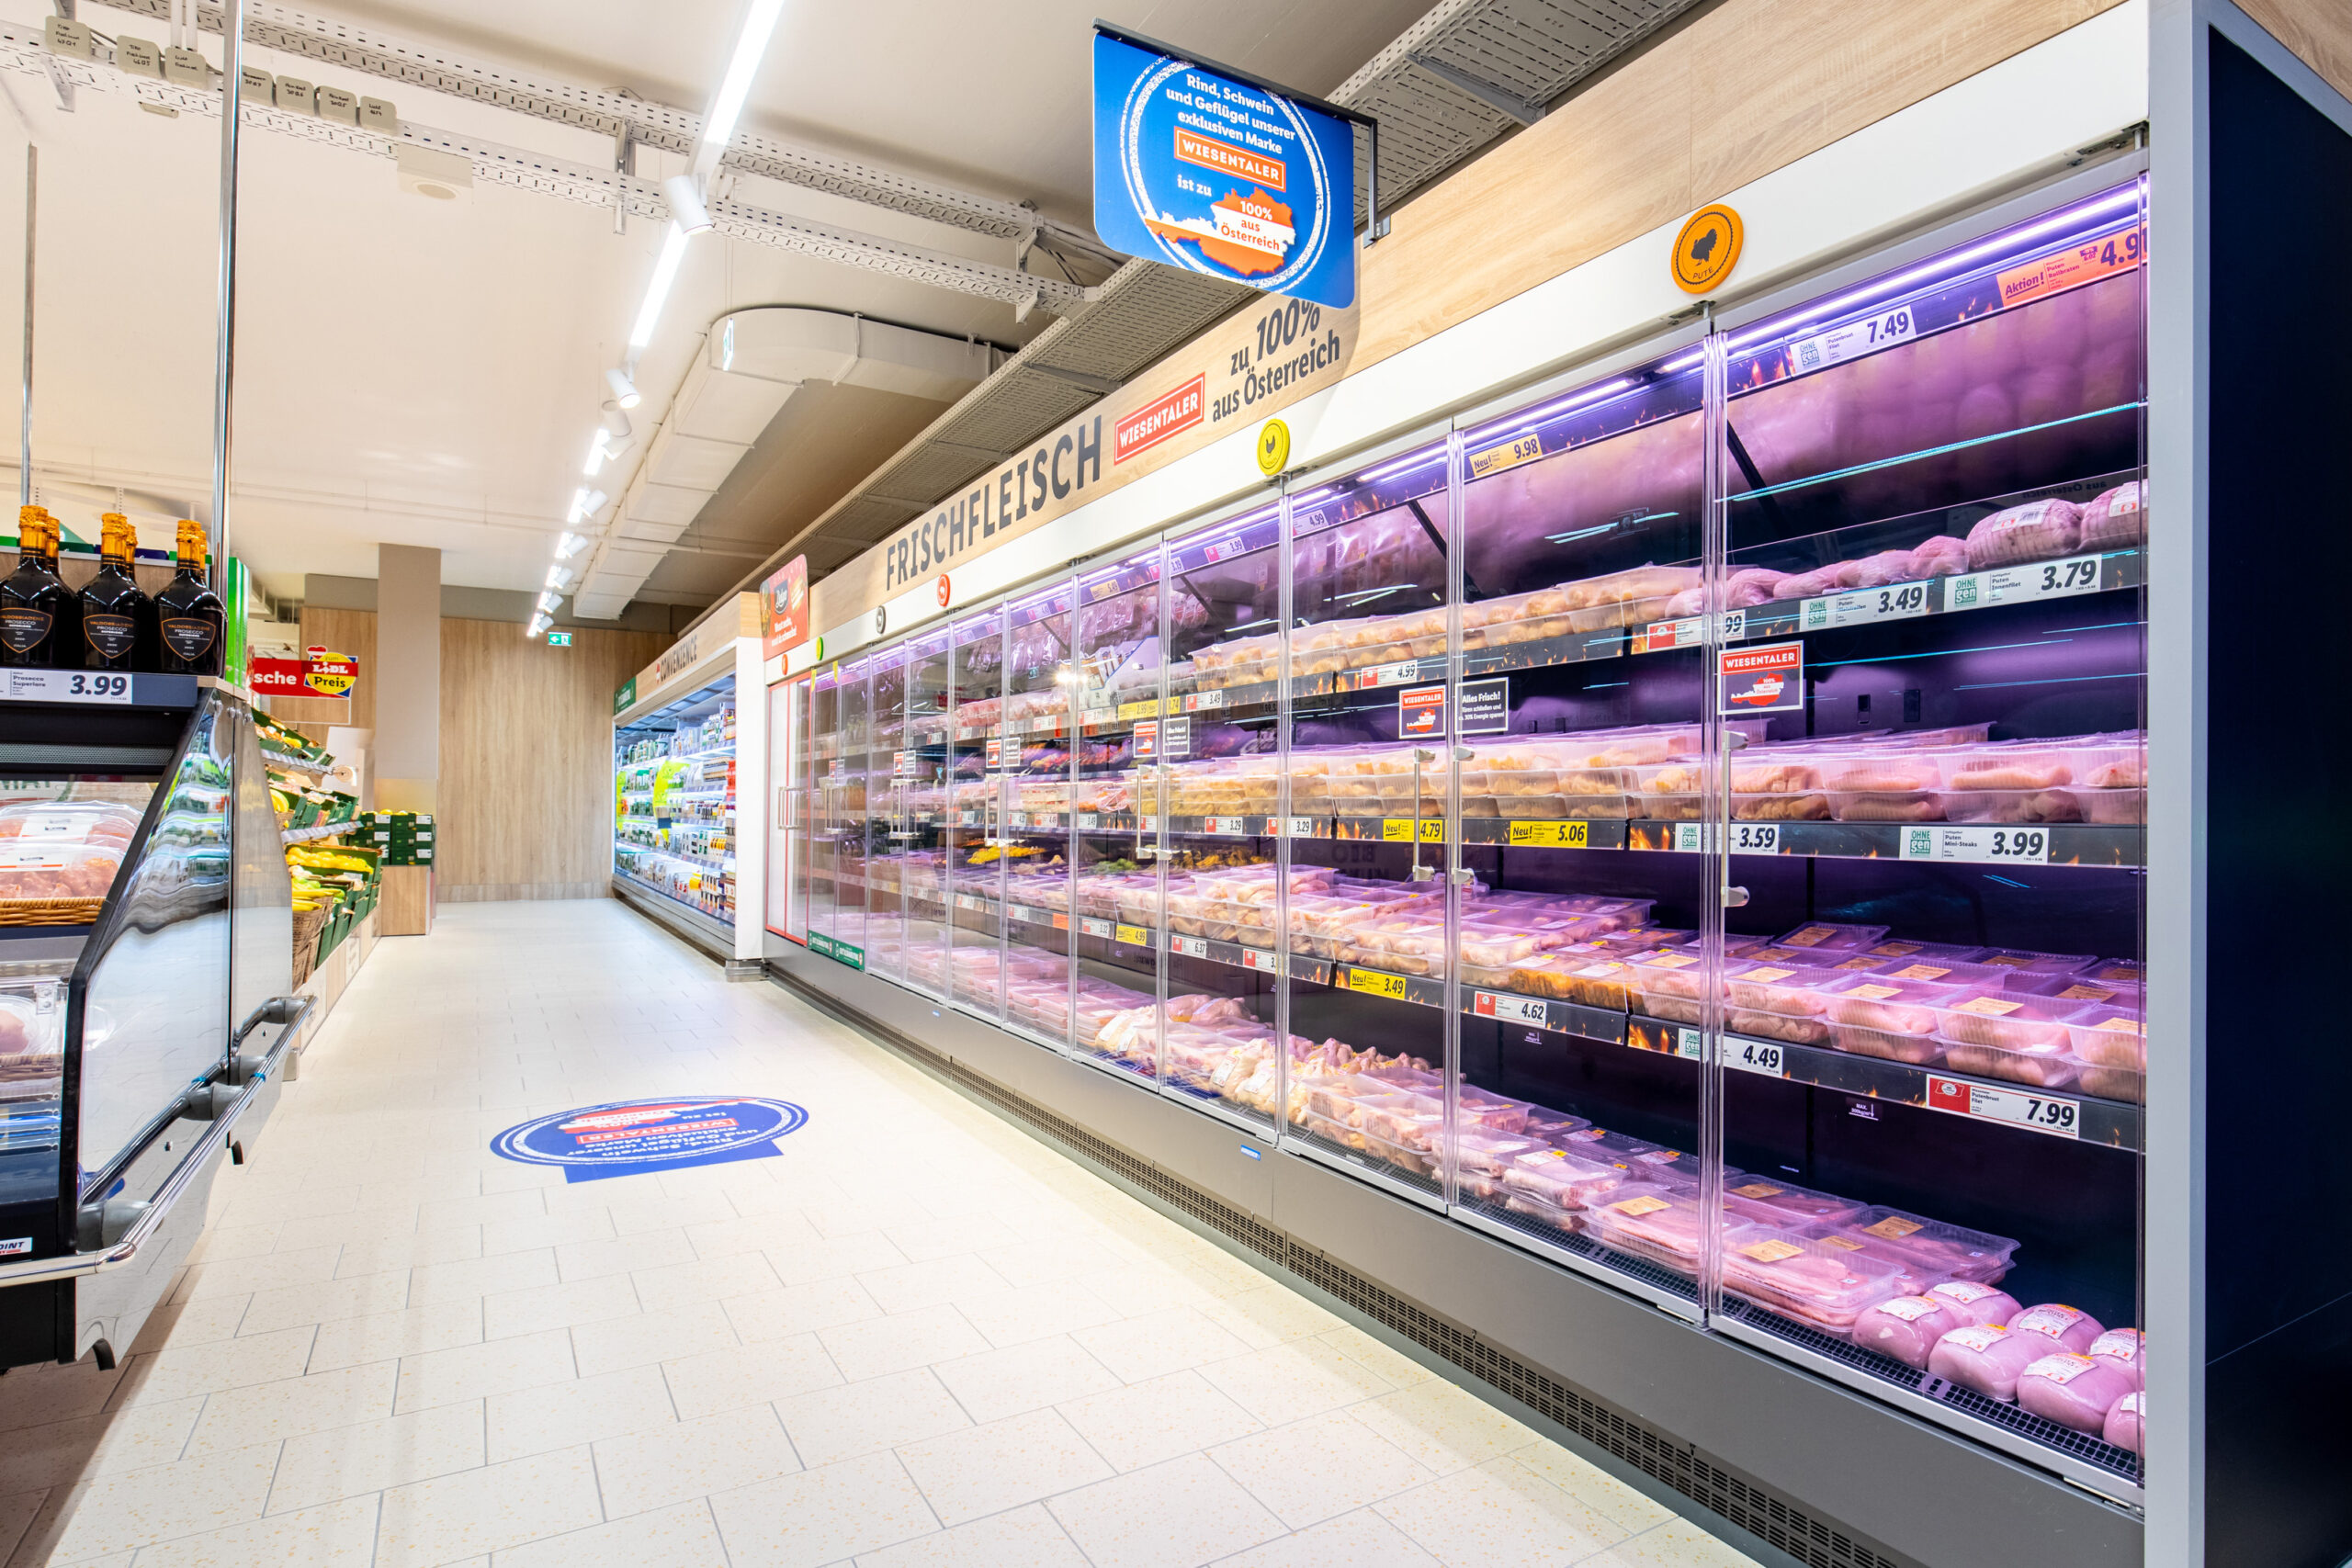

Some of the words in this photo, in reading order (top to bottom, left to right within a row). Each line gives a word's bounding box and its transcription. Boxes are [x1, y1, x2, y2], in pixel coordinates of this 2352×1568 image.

[1187, 73, 1221, 99] Rind,
[1224, 87, 1273, 116] Schwein
[1166, 88, 1193, 107] und
[1194, 96, 1250, 127] Geflügel
[1252, 117, 1295, 141] unserer
[1178, 112, 1243, 141] exklusiven
[1246, 134, 1283, 154] Marke
[1182, 138, 1279, 181] WIESENTALER
[1178, 175, 1193, 190] ist
[1196, 183, 1212, 197] zu
[1240, 200, 1272, 220] 100%
[1240, 220, 1261, 232] aus
[1221, 223, 1280, 251] Österreich
[1692, 266, 1713, 279] PUTE
[2047, 263, 2065, 272] Puten
[2048, 265, 2080, 278] Rollbraten
[2006, 272, 2044, 296] Aktion!
[1867, 311, 1909, 344] 7.49
[1230, 347, 1250, 378] zu
[1256, 299, 1321, 362] 100%
[1213, 388, 1239, 423] aus
[1244, 329, 1340, 406] Österreich
[1119, 392, 1199, 448] WIESENTALER
[1514, 438, 1538, 459] 9.98
[1474, 455, 1492, 470] Neu!
[886, 414, 1102, 592] FRISCHFLEISCH
[1309, 513, 1325, 526] 4.99
[1956, 578, 1977, 588] OHNE
[2041, 560, 2097, 591] 3.79
[1992, 582, 2021, 592] Innenfilet
[1878, 586, 1923, 614] 3.49
[1956, 588, 1977, 603] gen
[1810, 601, 1826, 610] OHNE
[312, 661, 348, 674] LIDL
[1725, 652, 1795, 669] WIESENTALER
[254, 671, 297, 685] sche
[1396, 664, 1416, 678] 4.99
[70, 674, 127, 696] 3.99
[314, 676, 345, 687] Preis
[1404, 694, 1442, 704] WIESENTALER
[1462, 694, 1477, 704] Alles
[1477, 691, 1501, 702] Frisch!
[1295, 821, 1310, 832] 3.29
[1385, 823, 1401, 836] Neu!
[1420, 823, 1441, 838] 4.79
[1512, 825, 1532, 840] Neu!
[1558, 825, 1586, 841] 5.06
[1739, 827, 1775, 848] 3.59
[1911, 829, 1930, 840] OHNE
[1910, 840, 1930, 853] gen
[1991, 831, 2043, 856] 3.99
[1352, 974, 1367, 987] Neu!
[1384, 977, 1404, 994] 3.49
[1521, 1003, 1544, 1020] 4.62
[1743, 1045, 1780, 1068] 4.49
[1972, 1091, 1999, 1102] Putenbrust
[2027, 1099, 2075, 1127] 7.99
[587, 1122, 728, 1141] WIESENTALER
[729, 1128, 759, 1137] und
[584, 1138, 641, 1148] Marke
[602, 1144, 680, 1156] Schwein
